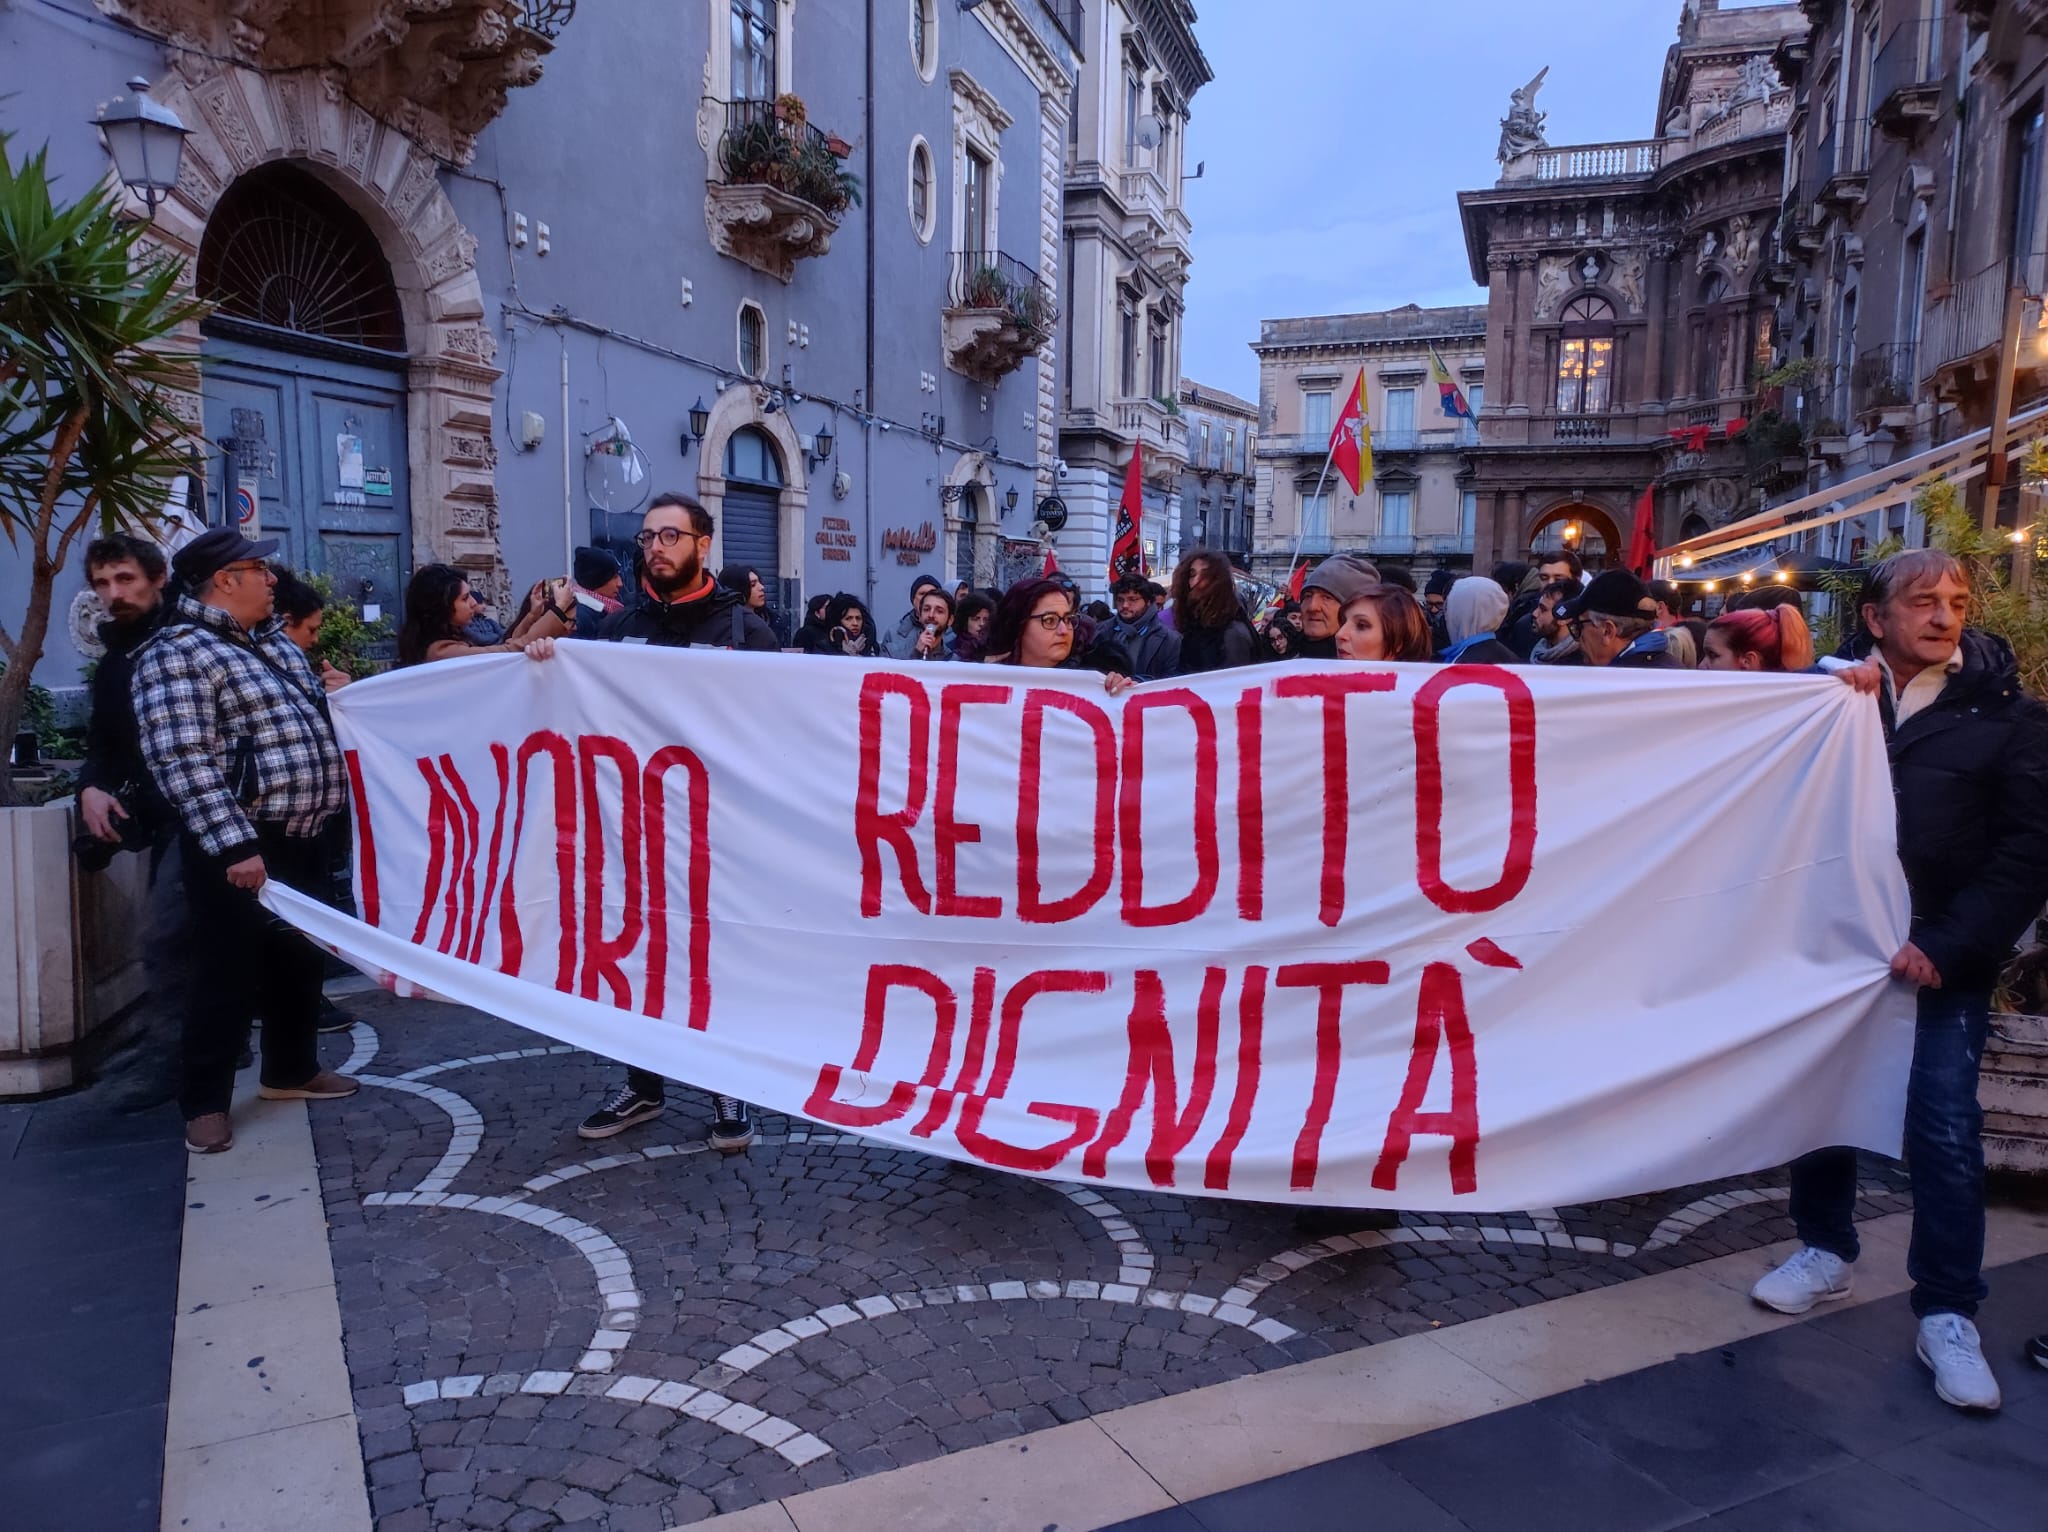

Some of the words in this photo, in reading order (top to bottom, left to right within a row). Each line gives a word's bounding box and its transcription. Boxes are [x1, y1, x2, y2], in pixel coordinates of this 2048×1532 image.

[815, 532, 833, 545] GRILL
[835, 533, 856, 547] HOUSE
[855, 663, 1538, 928] REDDITO
[803, 936, 1523, 1195] DIGNITÀ
